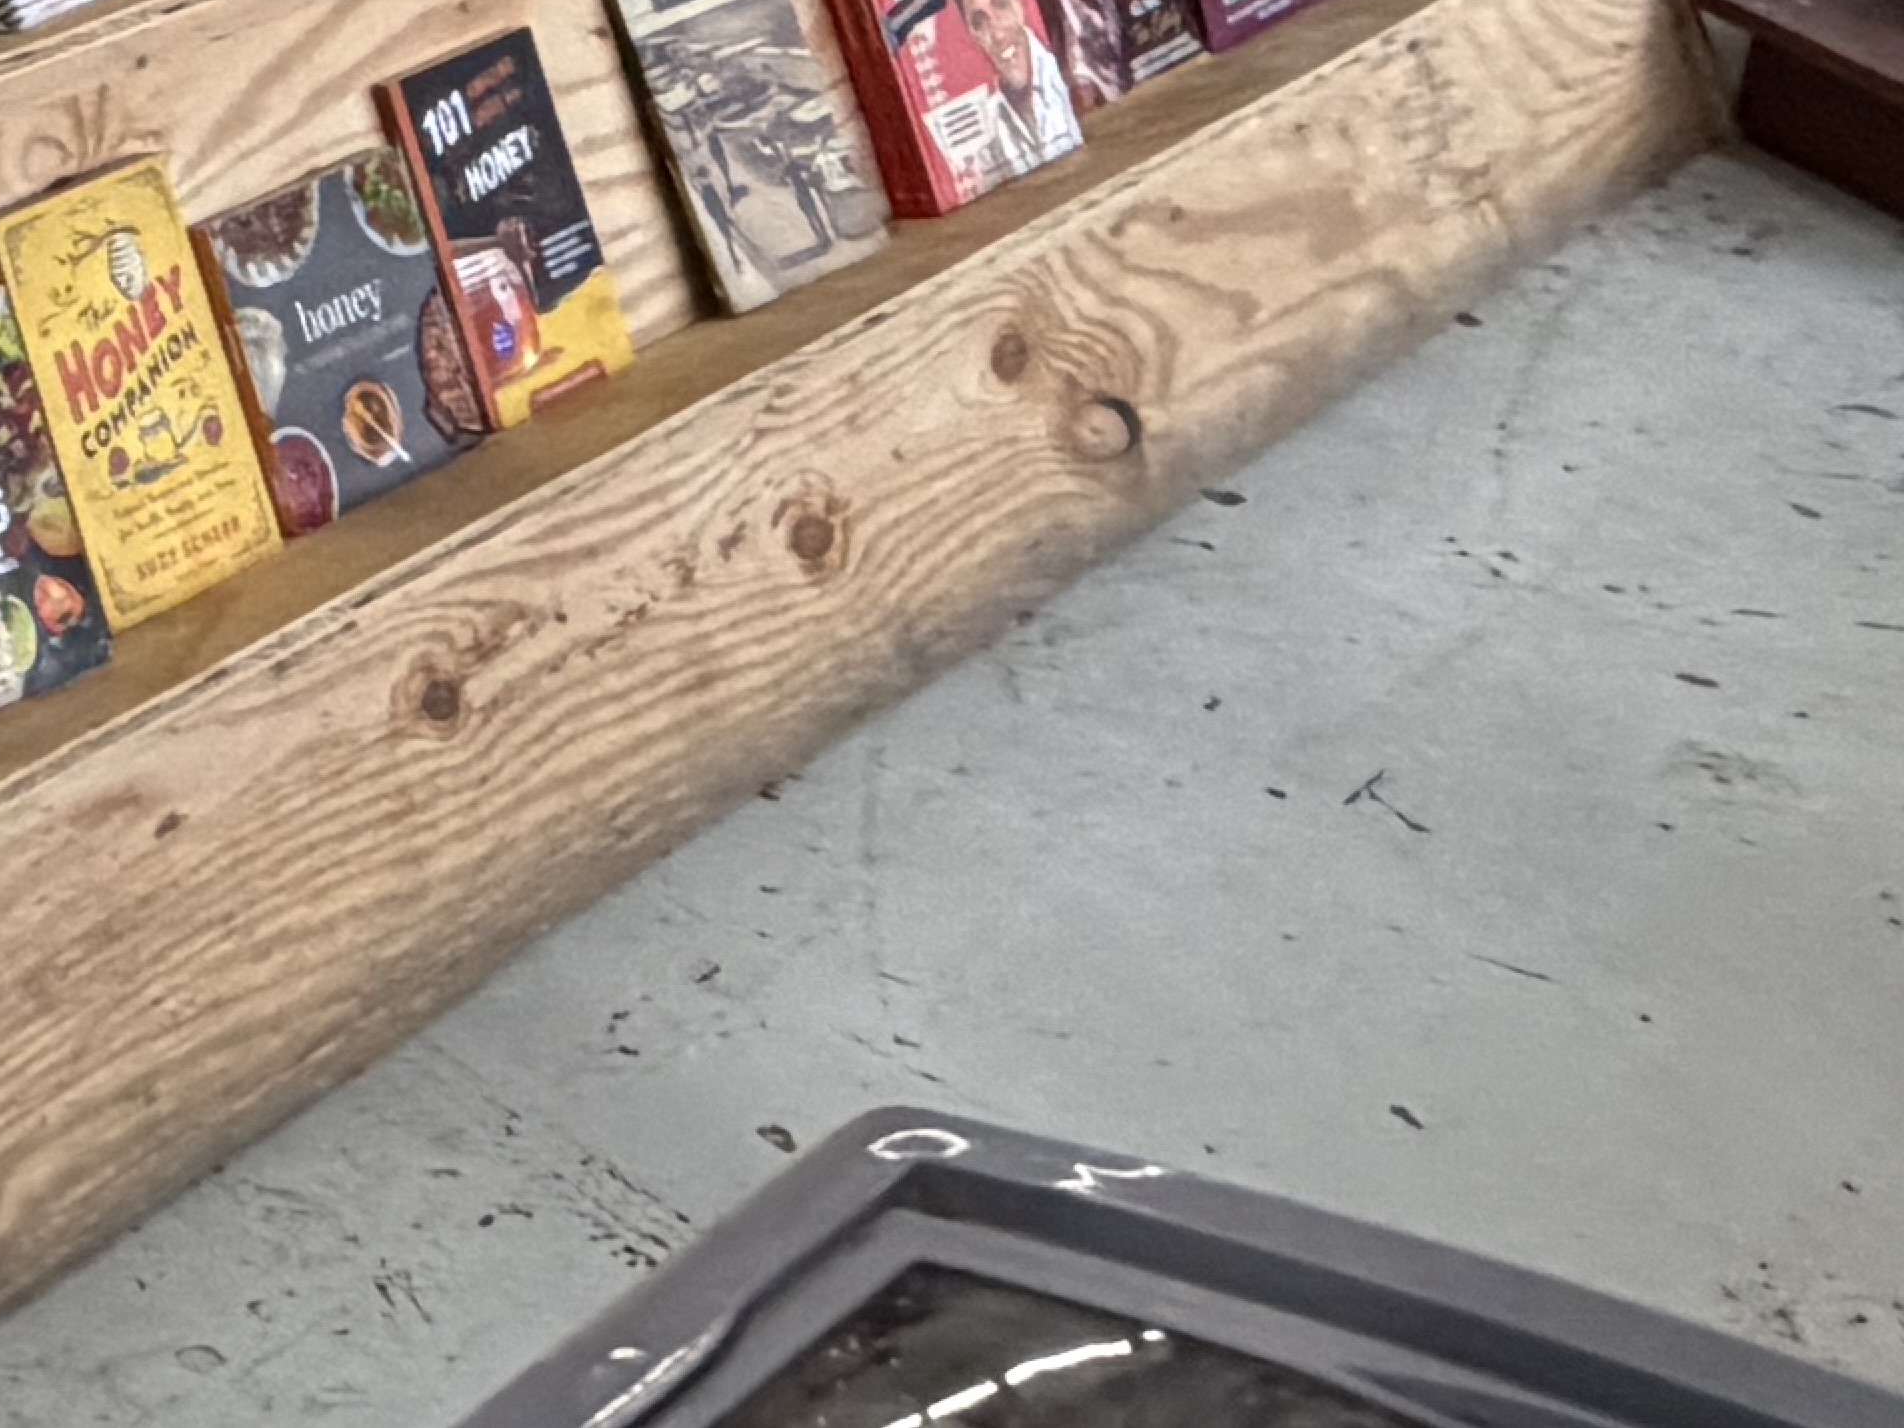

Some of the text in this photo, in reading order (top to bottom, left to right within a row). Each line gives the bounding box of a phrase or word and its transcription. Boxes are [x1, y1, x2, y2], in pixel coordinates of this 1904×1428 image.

[421, 88, 473, 157] 101
[463, 124, 535, 203] HONEY
[53, 263, 185, 424] HONEY
[294, 279, 386, 344] honey
[79, 321, 200, 458] COMPANION
